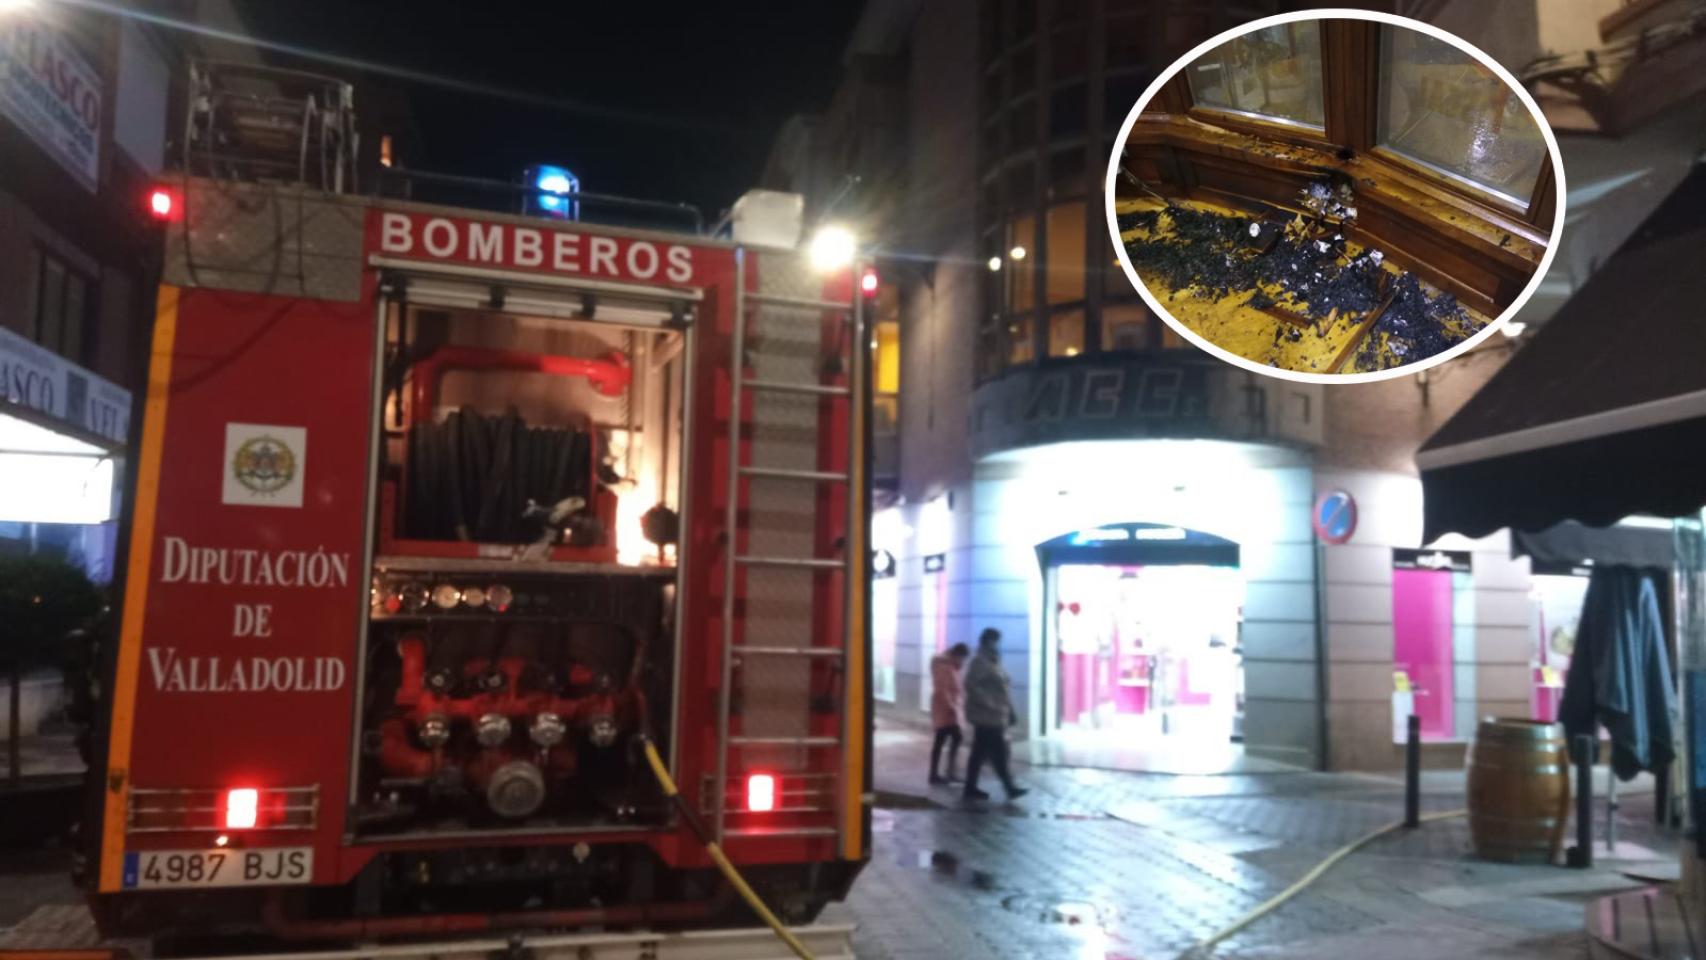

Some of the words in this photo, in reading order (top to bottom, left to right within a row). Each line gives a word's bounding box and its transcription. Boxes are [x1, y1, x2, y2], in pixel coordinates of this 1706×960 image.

[380, 212, 694, 283] BOMBEROS
[161, 536, 350, 588] DIPUTACIÓN
[233, 604, 272, 638] DE
[147, 646, 346, 692] VALLADOLID
[144, 853, 227, 883] 4987
[244, 850, 306, 880] BJS
